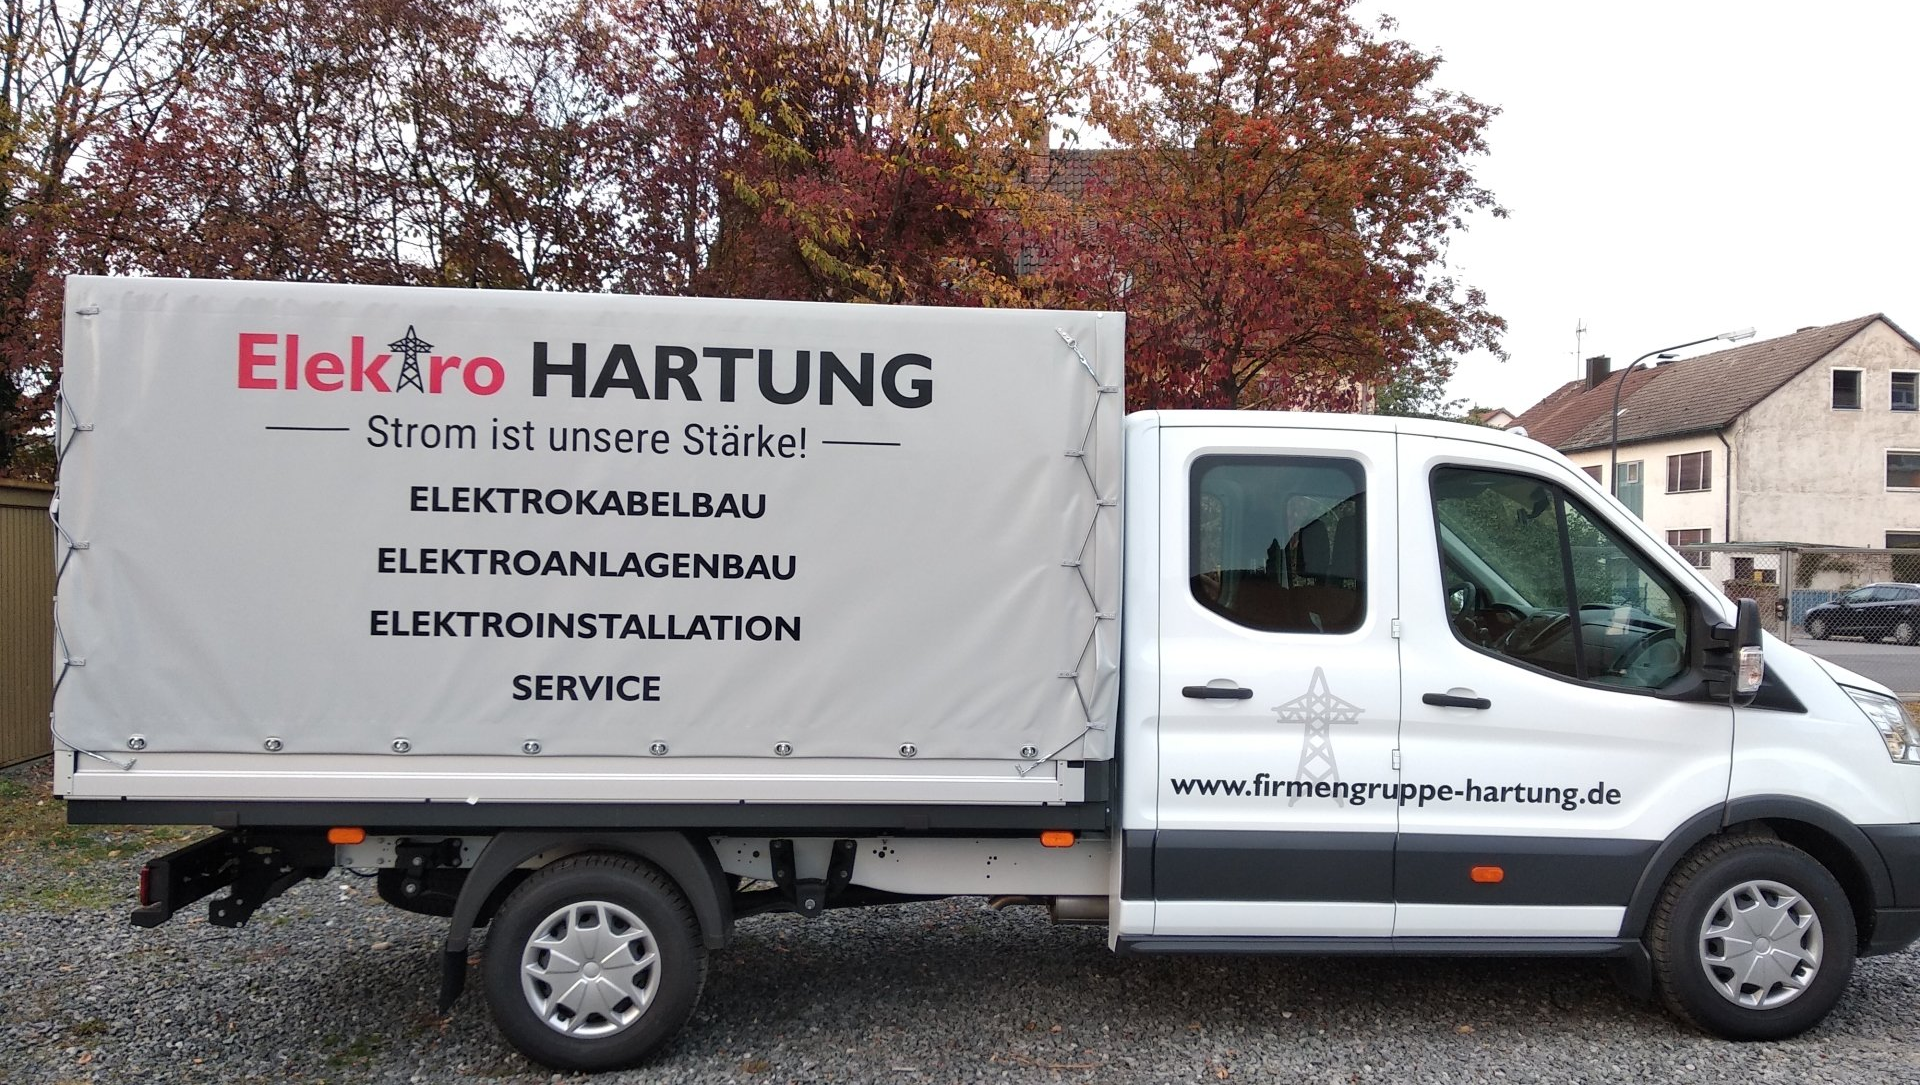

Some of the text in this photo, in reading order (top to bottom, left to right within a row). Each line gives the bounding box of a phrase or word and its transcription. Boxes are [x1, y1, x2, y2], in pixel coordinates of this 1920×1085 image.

[532, 341, 933, 409] HARTUNG
[367, 414, 806, 459] Strom ist unsere Stärke!
[410, 485, 766, 519] ELEKTROKABELBAU
[378, 547, 796, 581] ELEKTROANLAGENBAU
[370, 610, 801, 642] ELEKTROINSTALLATION
[512, 674, 661, 702] SERVICE
[1170, 773, 1622, 811] www.firmengruppe-hartung.de
